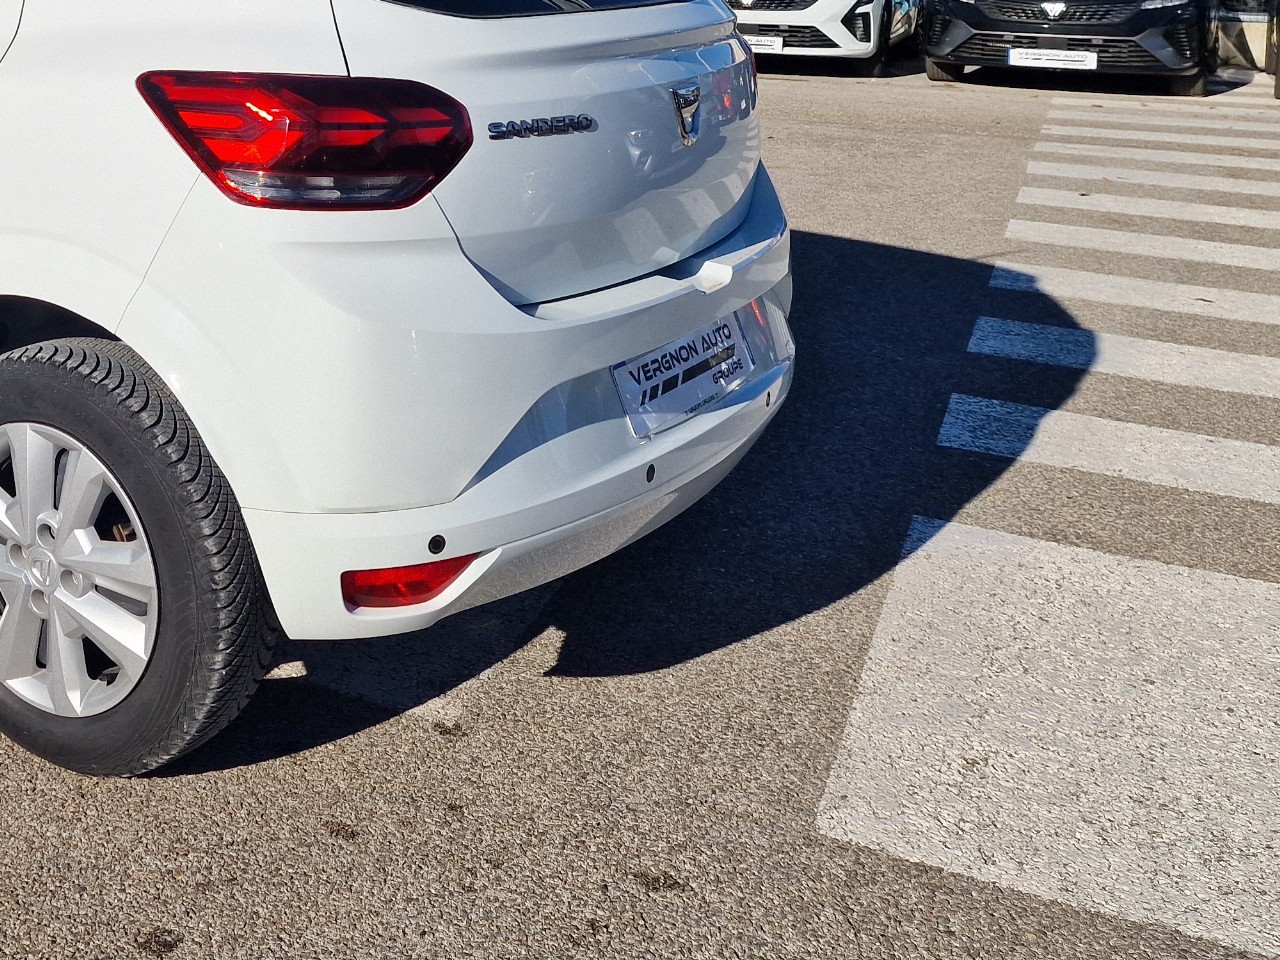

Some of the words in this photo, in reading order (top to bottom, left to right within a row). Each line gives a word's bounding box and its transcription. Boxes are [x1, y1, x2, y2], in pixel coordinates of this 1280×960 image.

[487, 113, 594, 140] SANDERO
[629, 339, 700, 386] VERGNON
[701, 323, 732, 354] AUTO
[712, 358, 744, 385] GROUPE
